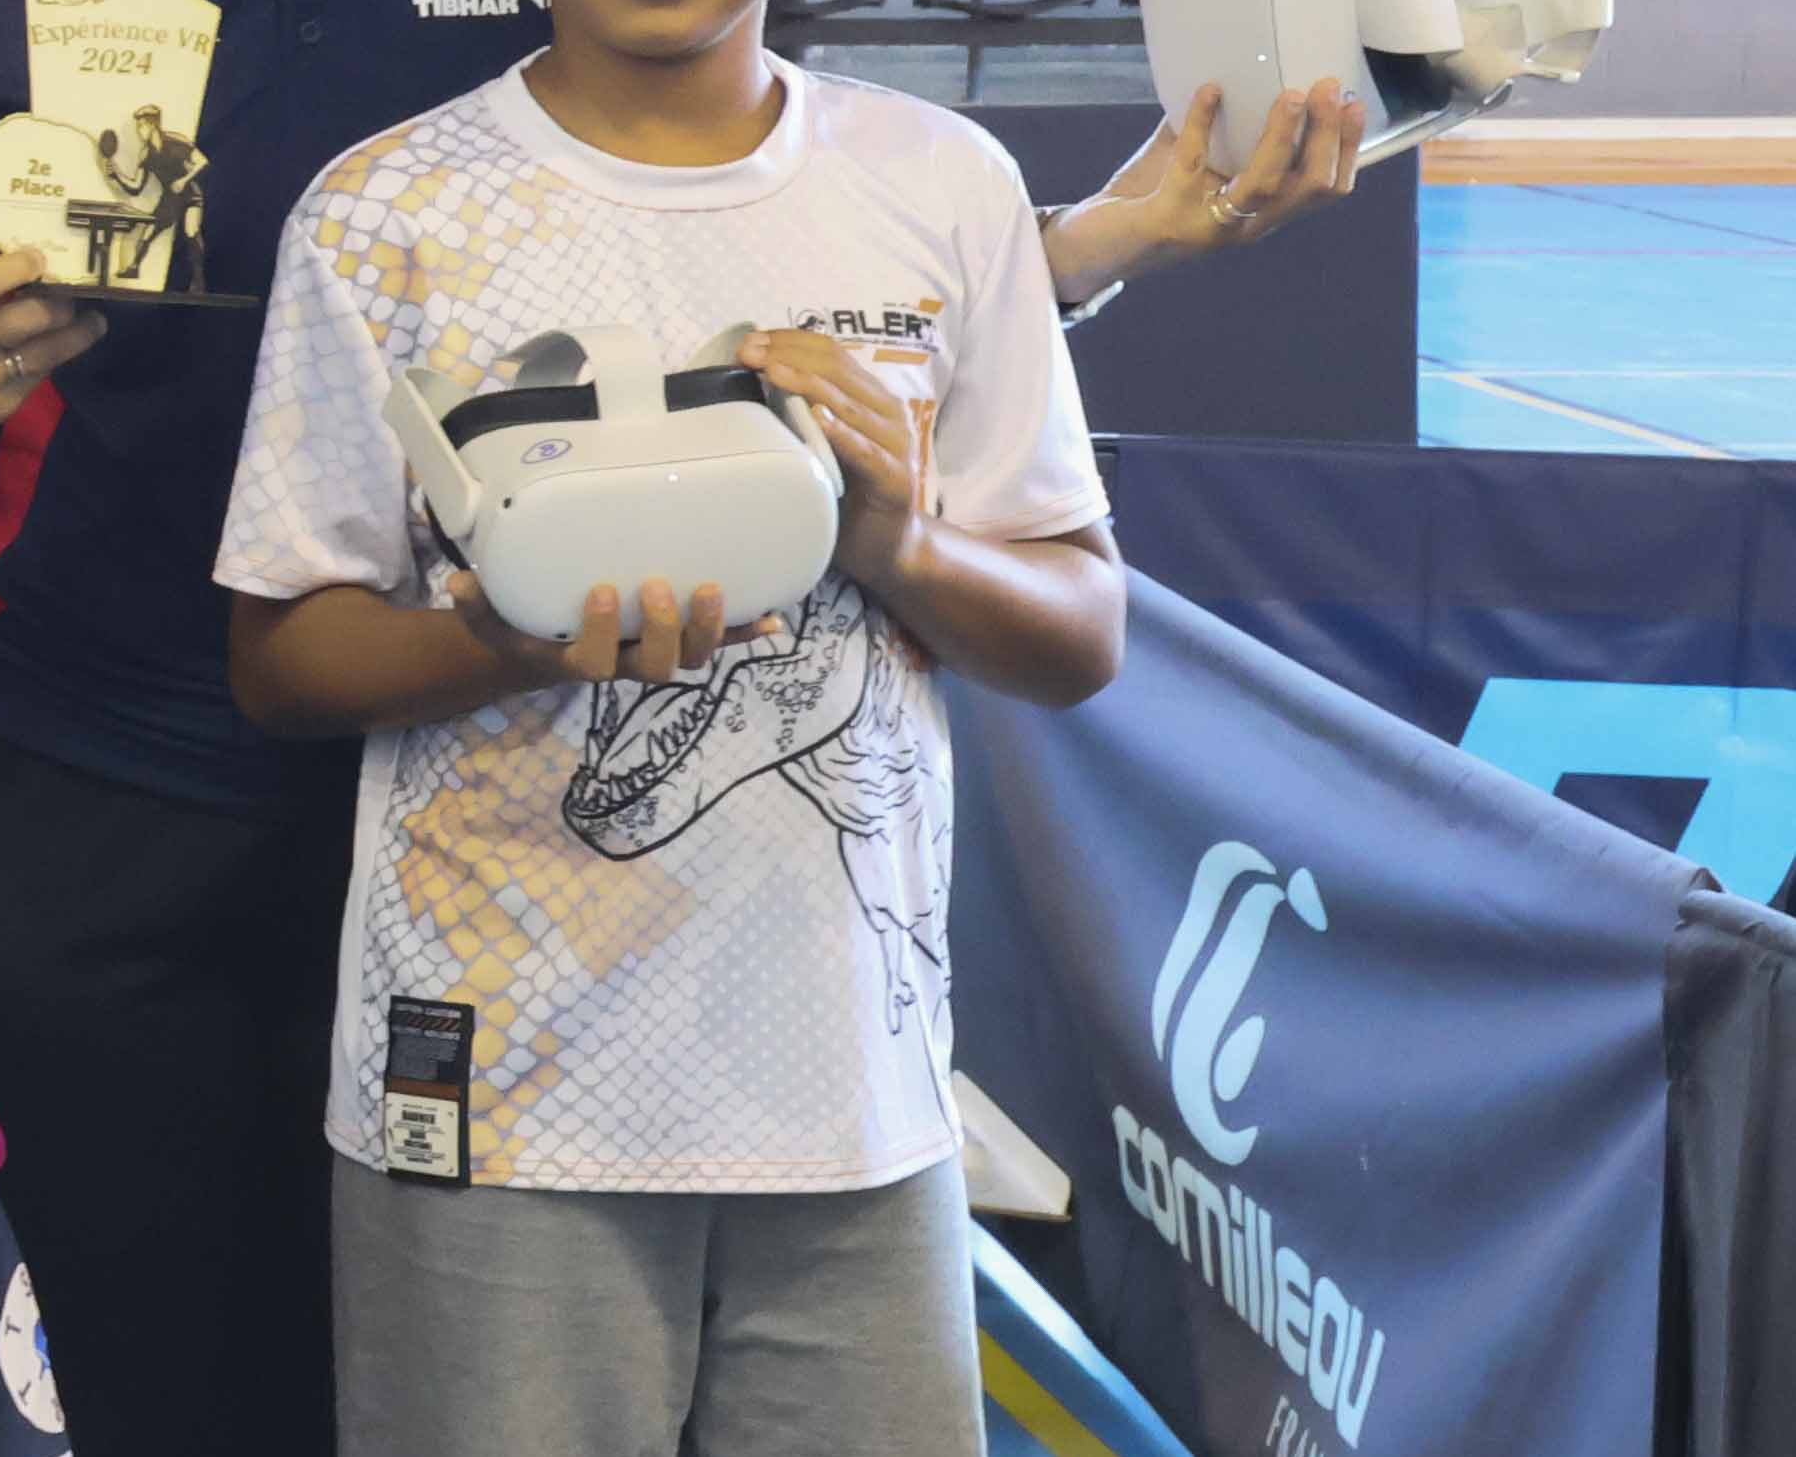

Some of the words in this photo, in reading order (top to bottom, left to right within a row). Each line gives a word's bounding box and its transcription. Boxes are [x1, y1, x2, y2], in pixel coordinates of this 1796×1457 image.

[177, 30, 211, 56] VR
[78, 47, 154, 76] 2024
[27, 158, 52, 177] 2e
[10, 177, 65, 197] Place
